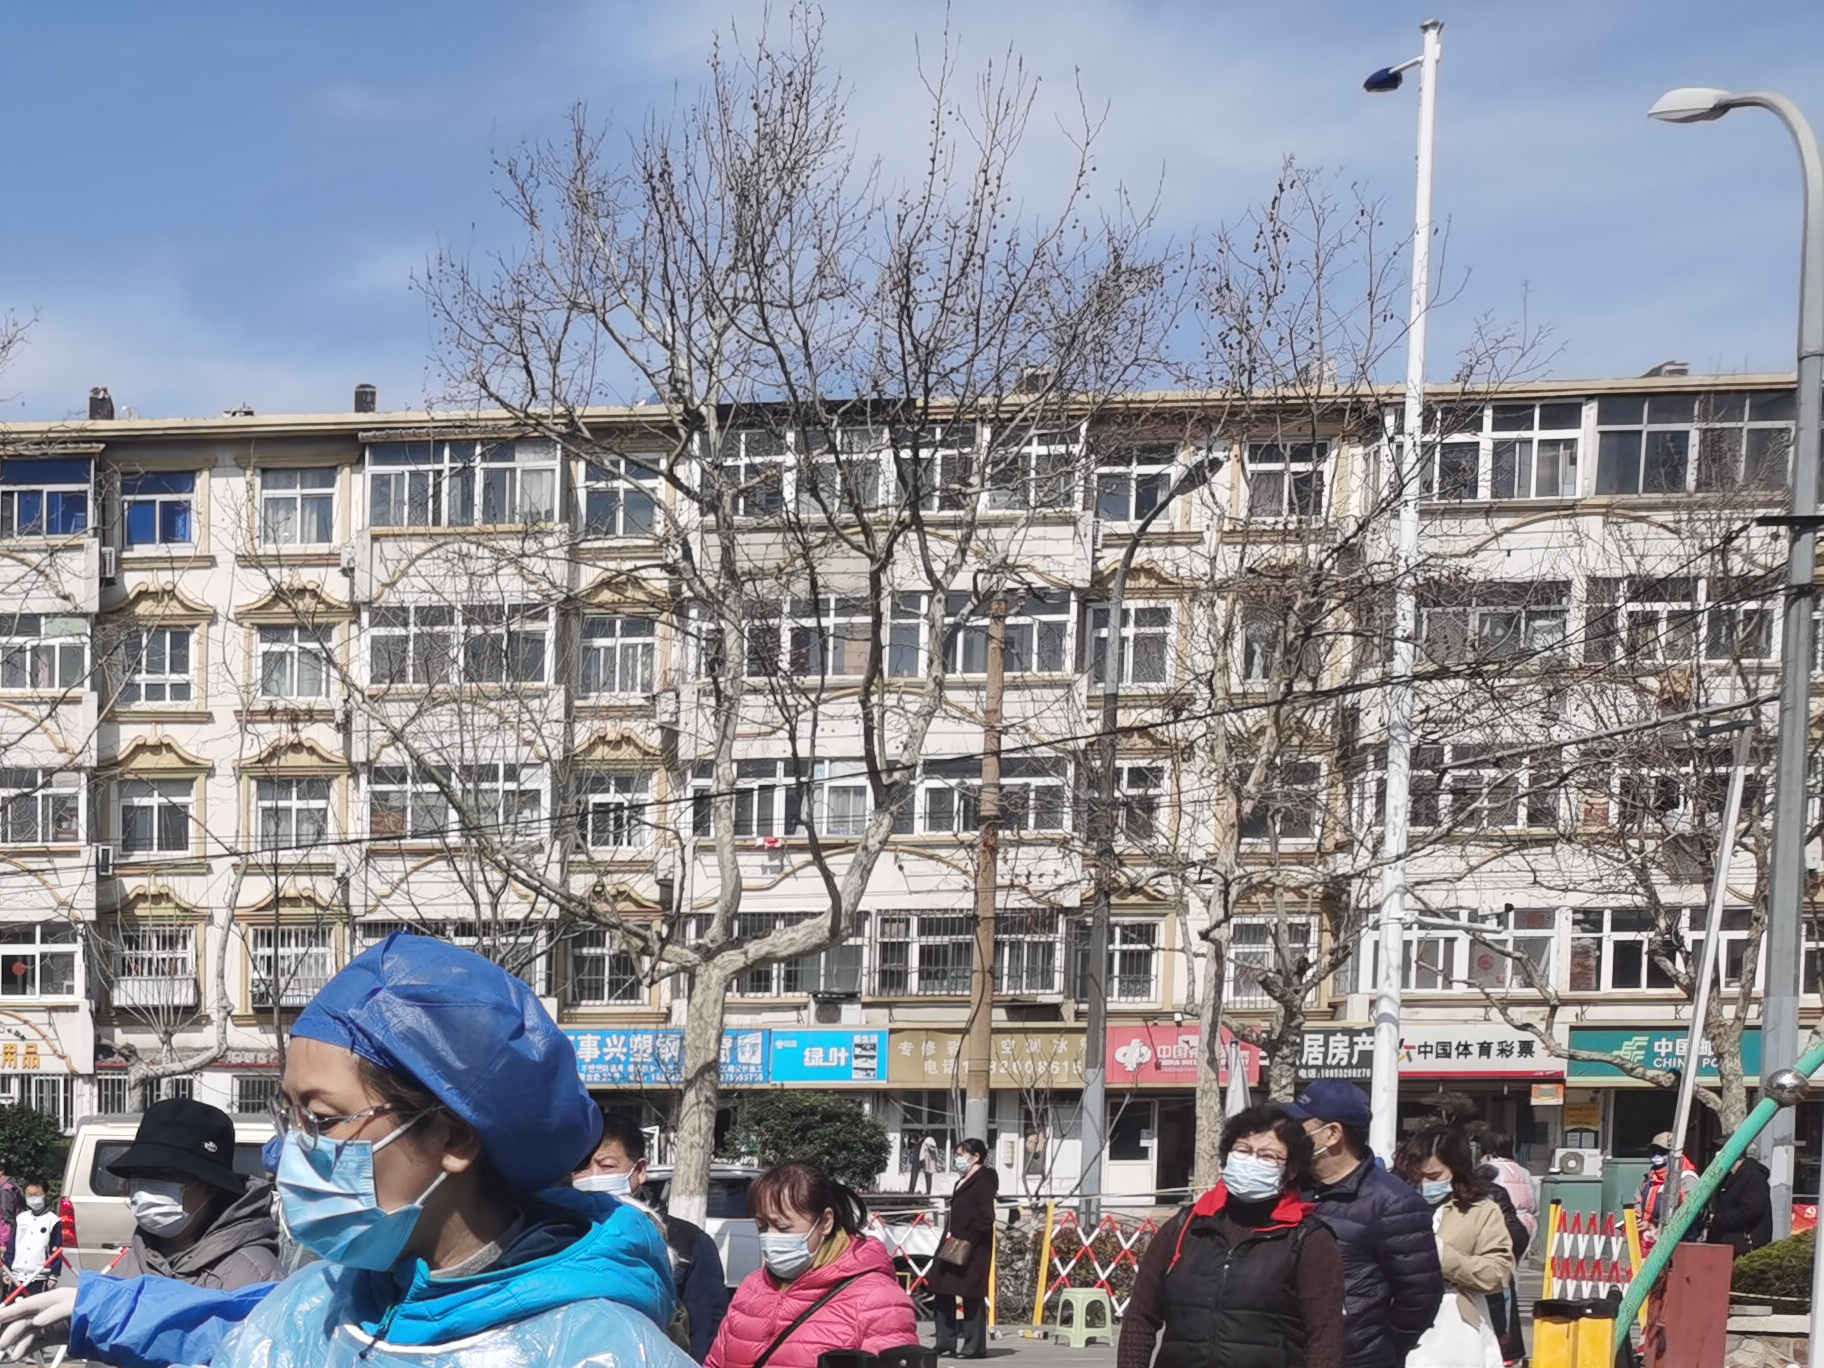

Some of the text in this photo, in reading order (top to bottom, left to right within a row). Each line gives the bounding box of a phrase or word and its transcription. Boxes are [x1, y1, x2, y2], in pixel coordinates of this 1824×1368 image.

[803, 1047, 850, 1067] 绿叶
[1417, 1039, 1536, 1060] 中国体育彩票
[1653, 1037, 1715, 1057] 中国邮
[1653, 1057, 1719, 1068] CHIN PO
